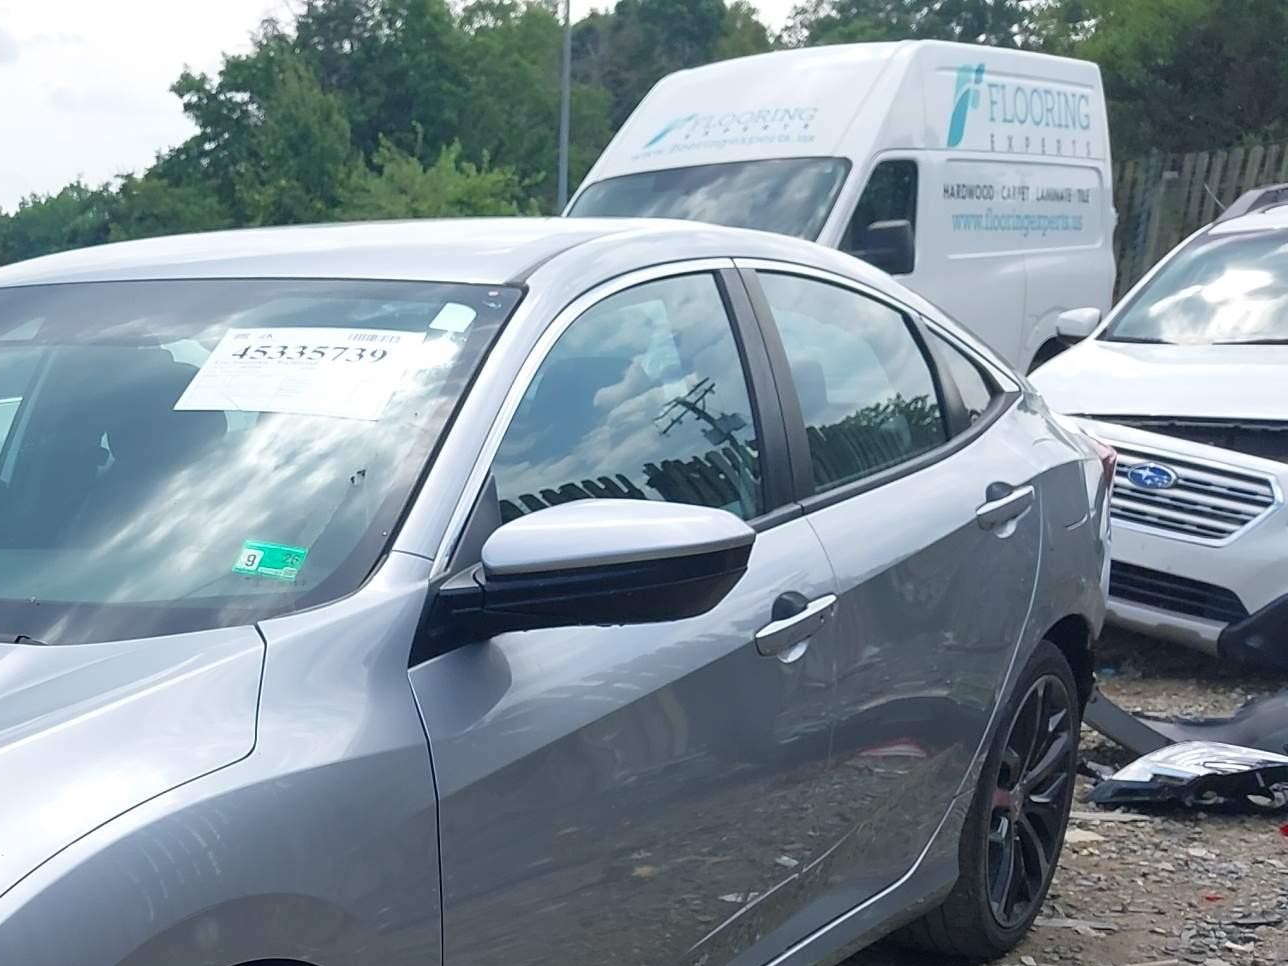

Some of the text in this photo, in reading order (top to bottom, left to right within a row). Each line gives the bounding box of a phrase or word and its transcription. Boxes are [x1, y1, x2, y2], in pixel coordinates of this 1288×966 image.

[987, 83, 1091, 131] FLOORING
[943, 183, 995, 201] HARDWOOD
[231, 344, 388, 363] 45335739
[245, 553, 257, 567] 9
